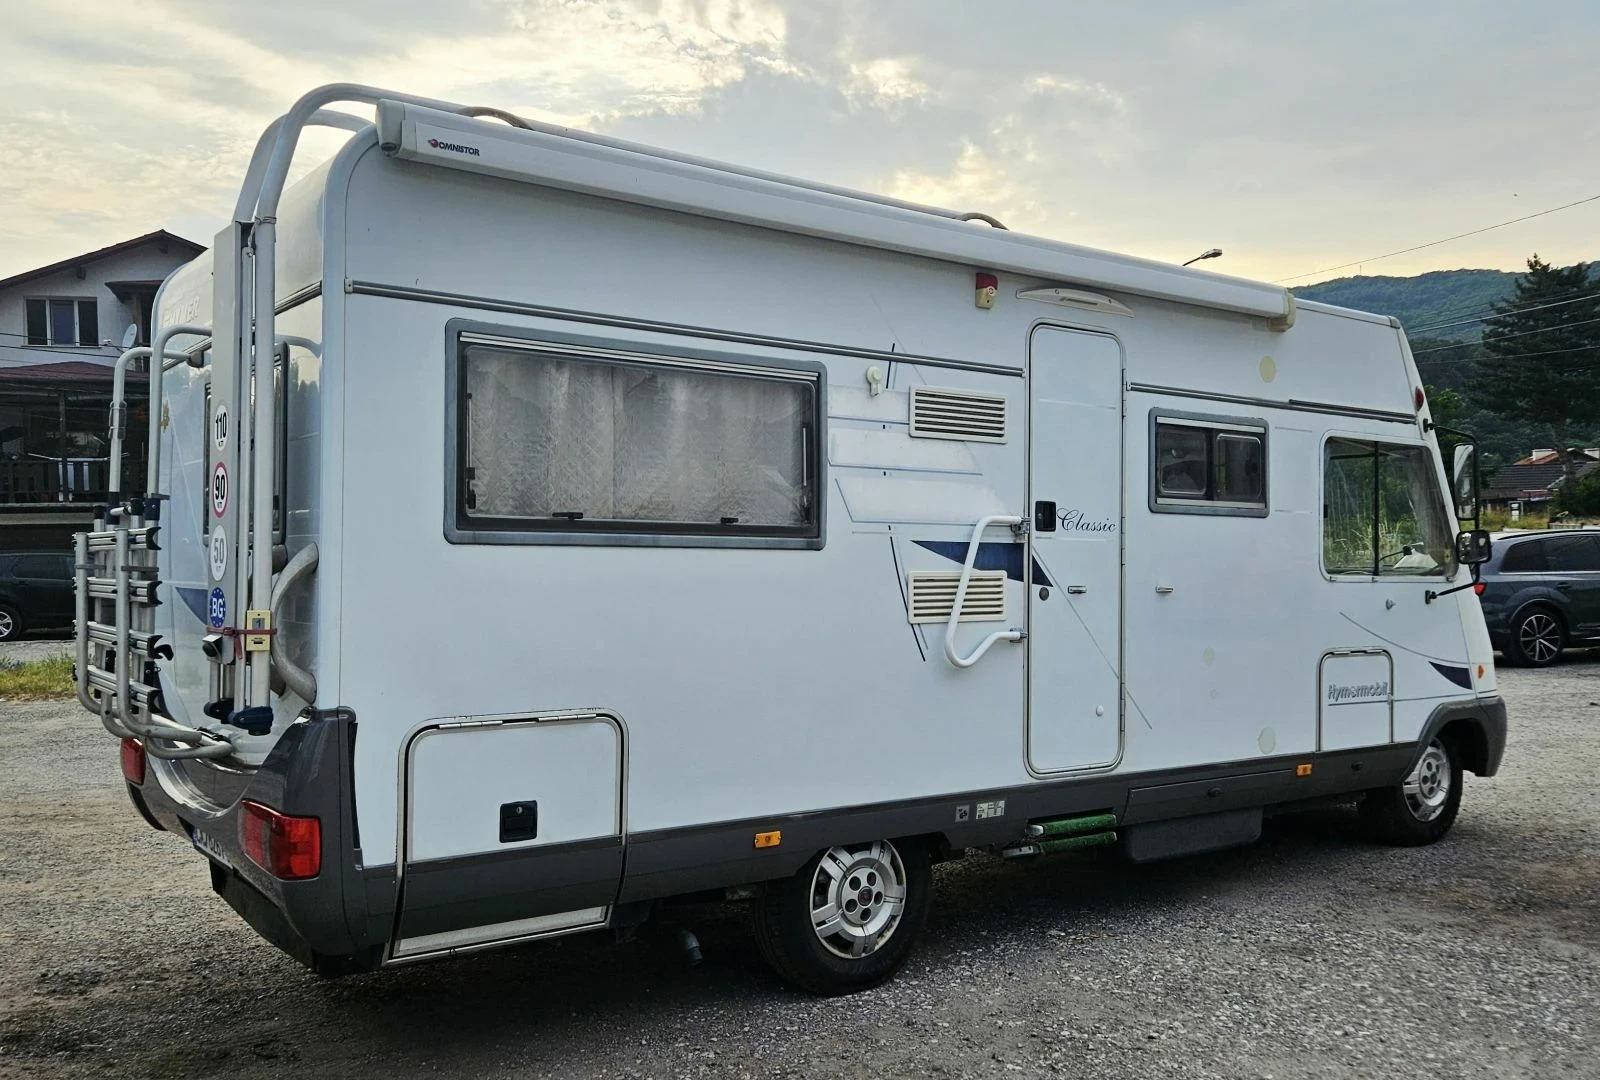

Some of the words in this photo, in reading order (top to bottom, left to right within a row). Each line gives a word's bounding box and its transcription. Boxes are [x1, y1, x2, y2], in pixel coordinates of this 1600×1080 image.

[438, 141, 481, 156] OMNISTOR
[215, 411, 228, 440] 110
[215, 474, 226, 501] 90
[1056, 507, 1117, 533] Classic
[213, 537, 225, 564] 50
[212, 597, 224, 619] BG
[1327, 681, 1388, 702] Hymermobil
